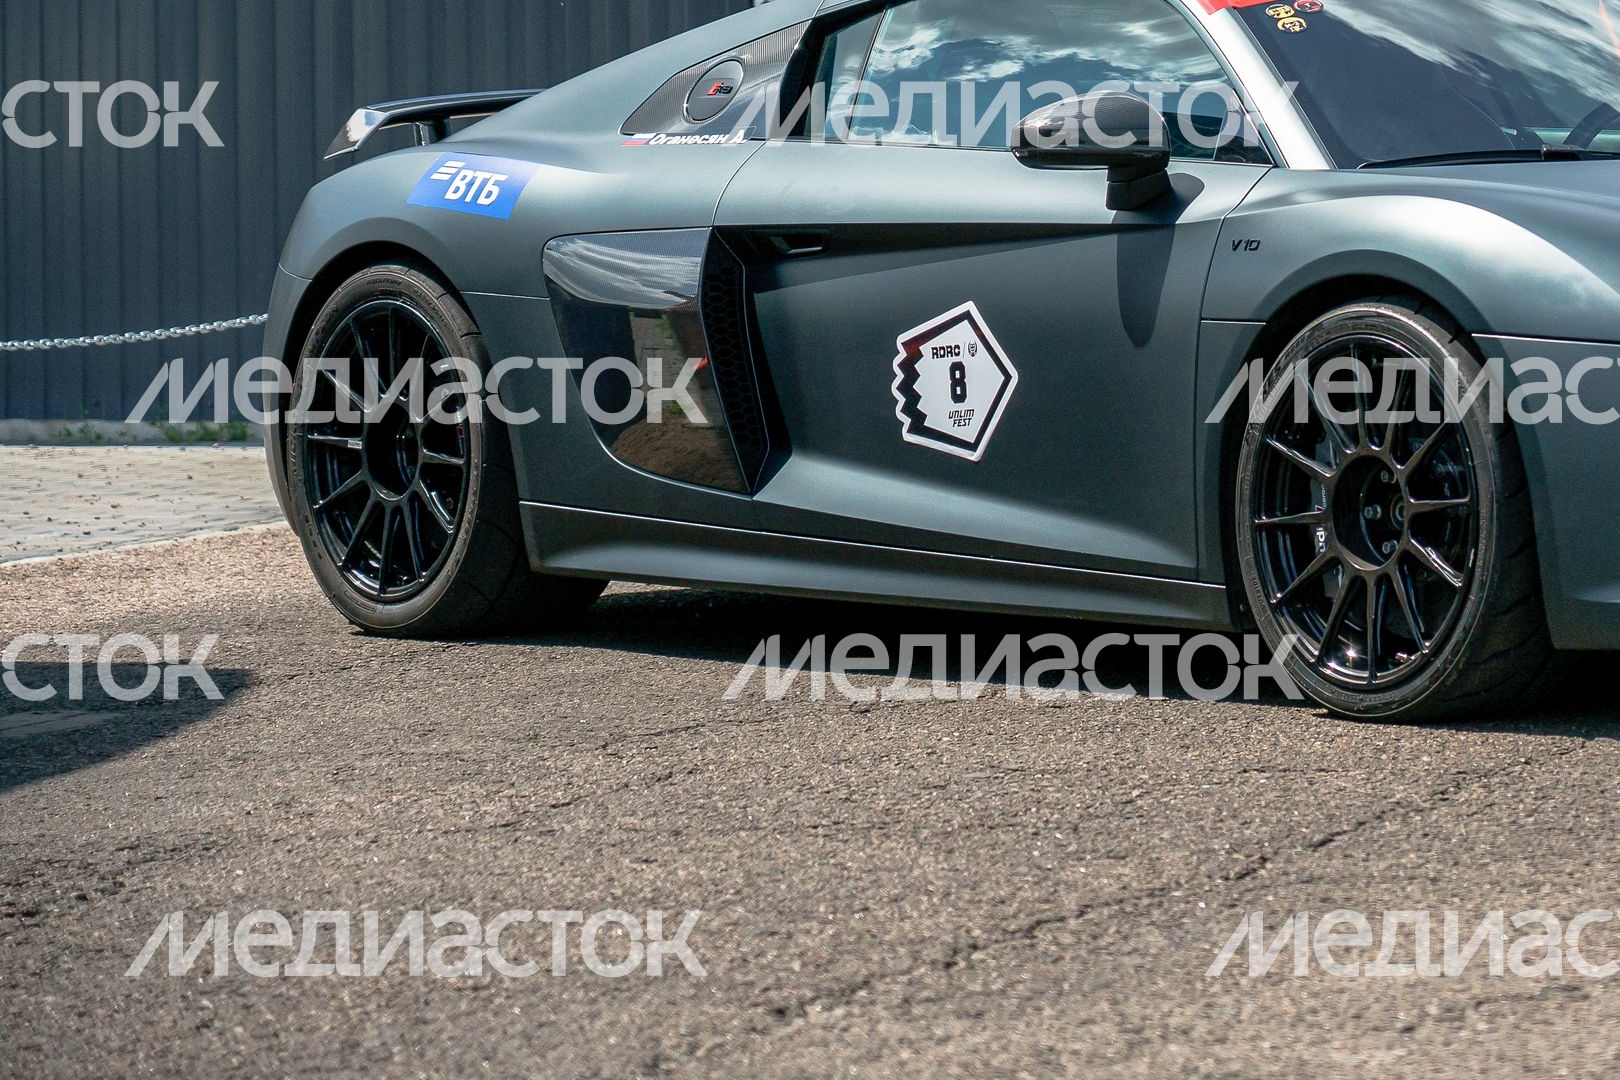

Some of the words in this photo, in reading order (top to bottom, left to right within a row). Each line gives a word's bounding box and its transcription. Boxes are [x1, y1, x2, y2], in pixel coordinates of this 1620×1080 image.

[444, 169, 509, 206] ВТБ
[931, 344, 961, 360] RDRC
[949, 361, 967, 404] 8
[952, 418, 972, 427] FEST
[1316, 527, 1325, 553] udi
